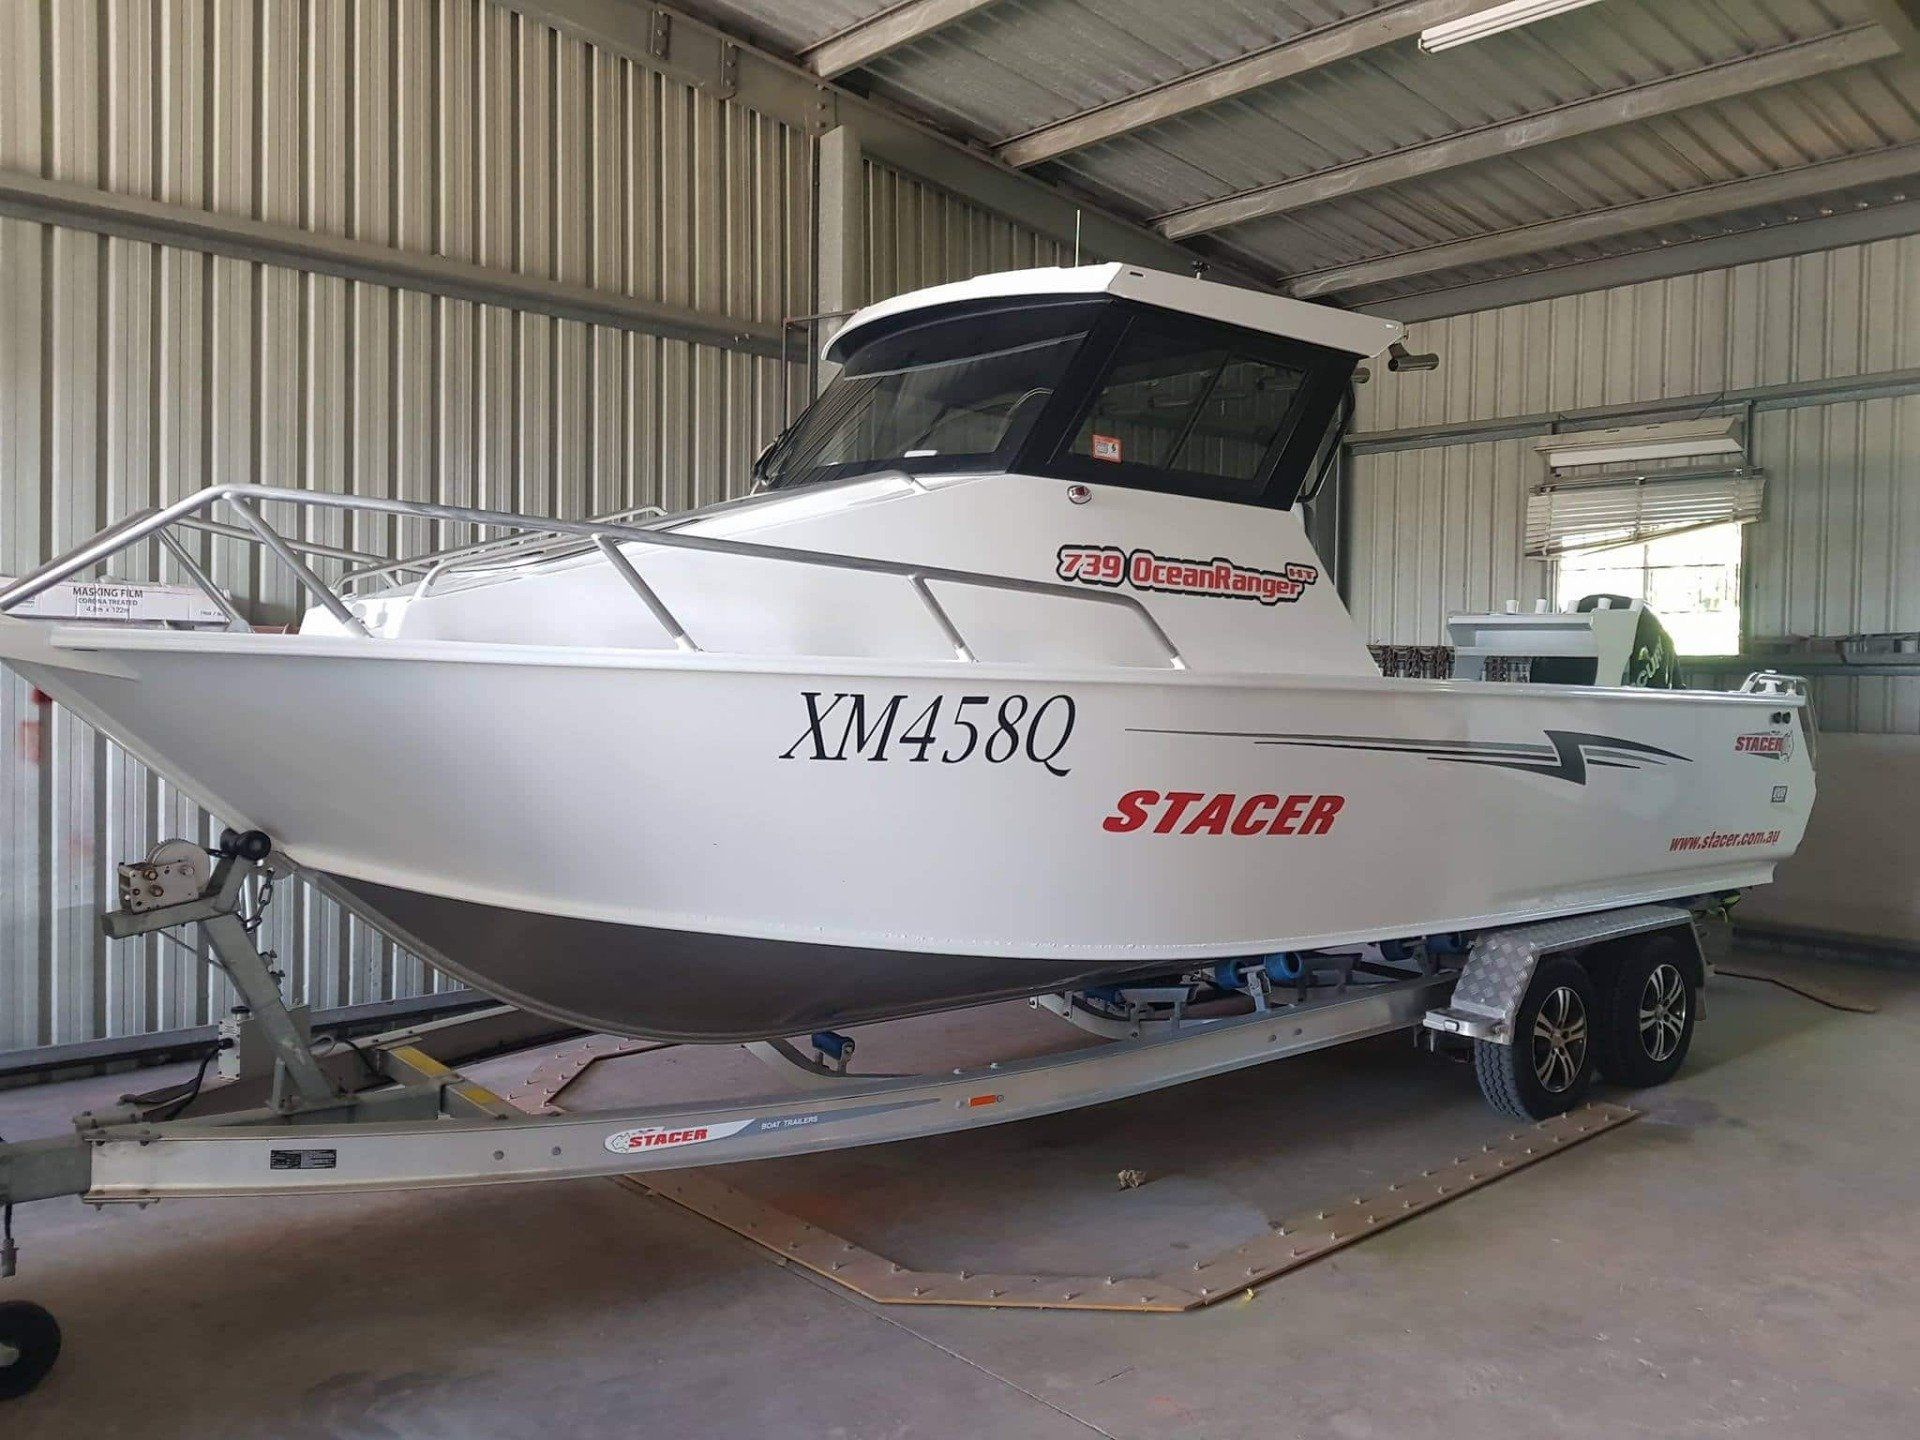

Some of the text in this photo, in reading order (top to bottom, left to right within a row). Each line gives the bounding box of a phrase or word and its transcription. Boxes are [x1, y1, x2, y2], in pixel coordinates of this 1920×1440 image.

[1063, 553, 1121, 579] 739
[1132, 556, 1300, 598] OceanRanger
[72, 587, 144, 599] MASKING FILM
[778, 691, 1078, 778] XM458Q
[1735, 735, 1785, 751] STACER
[1102, 789, 1346, 836] STACER
[1669, 829, 1781, 851] www.stacer.com.au
[760, 1115, 818, 1131] BOAT TRAILERS
[628, 1128, 708, 1148] STACER
